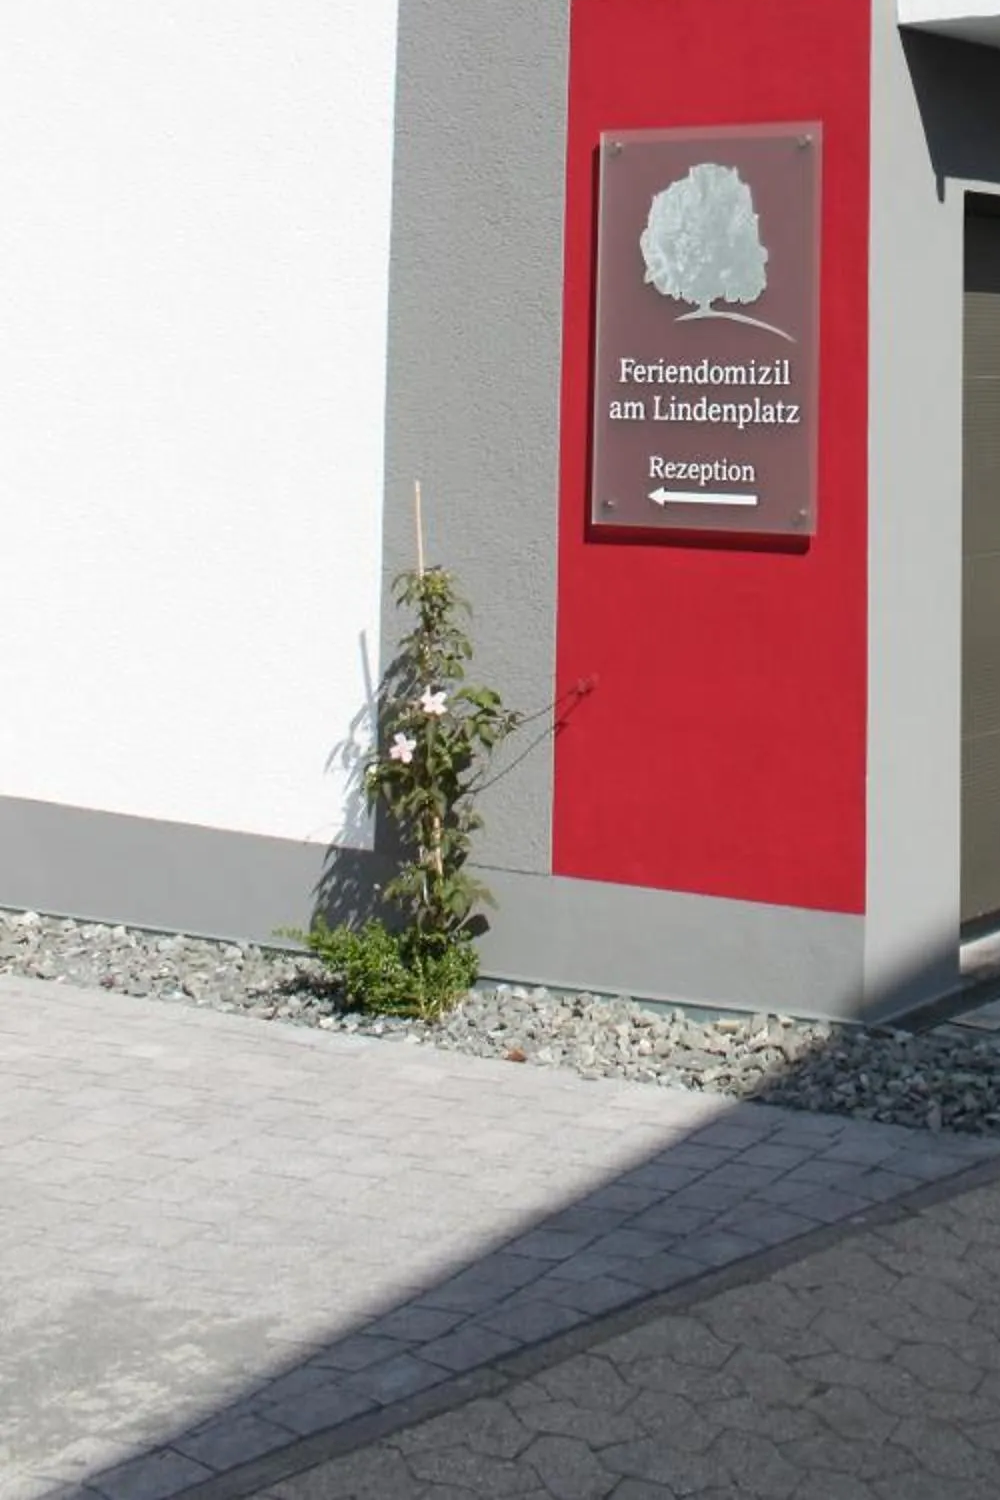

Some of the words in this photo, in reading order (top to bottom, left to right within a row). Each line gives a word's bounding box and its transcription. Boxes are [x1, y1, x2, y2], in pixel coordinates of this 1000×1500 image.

[618, 358, 791, 386] Feriendomizil
[609, 399, 645, 421] am
[653, 395, 800, 429] Lindenplatz
[648, 455, 756, 485] Rezeption
